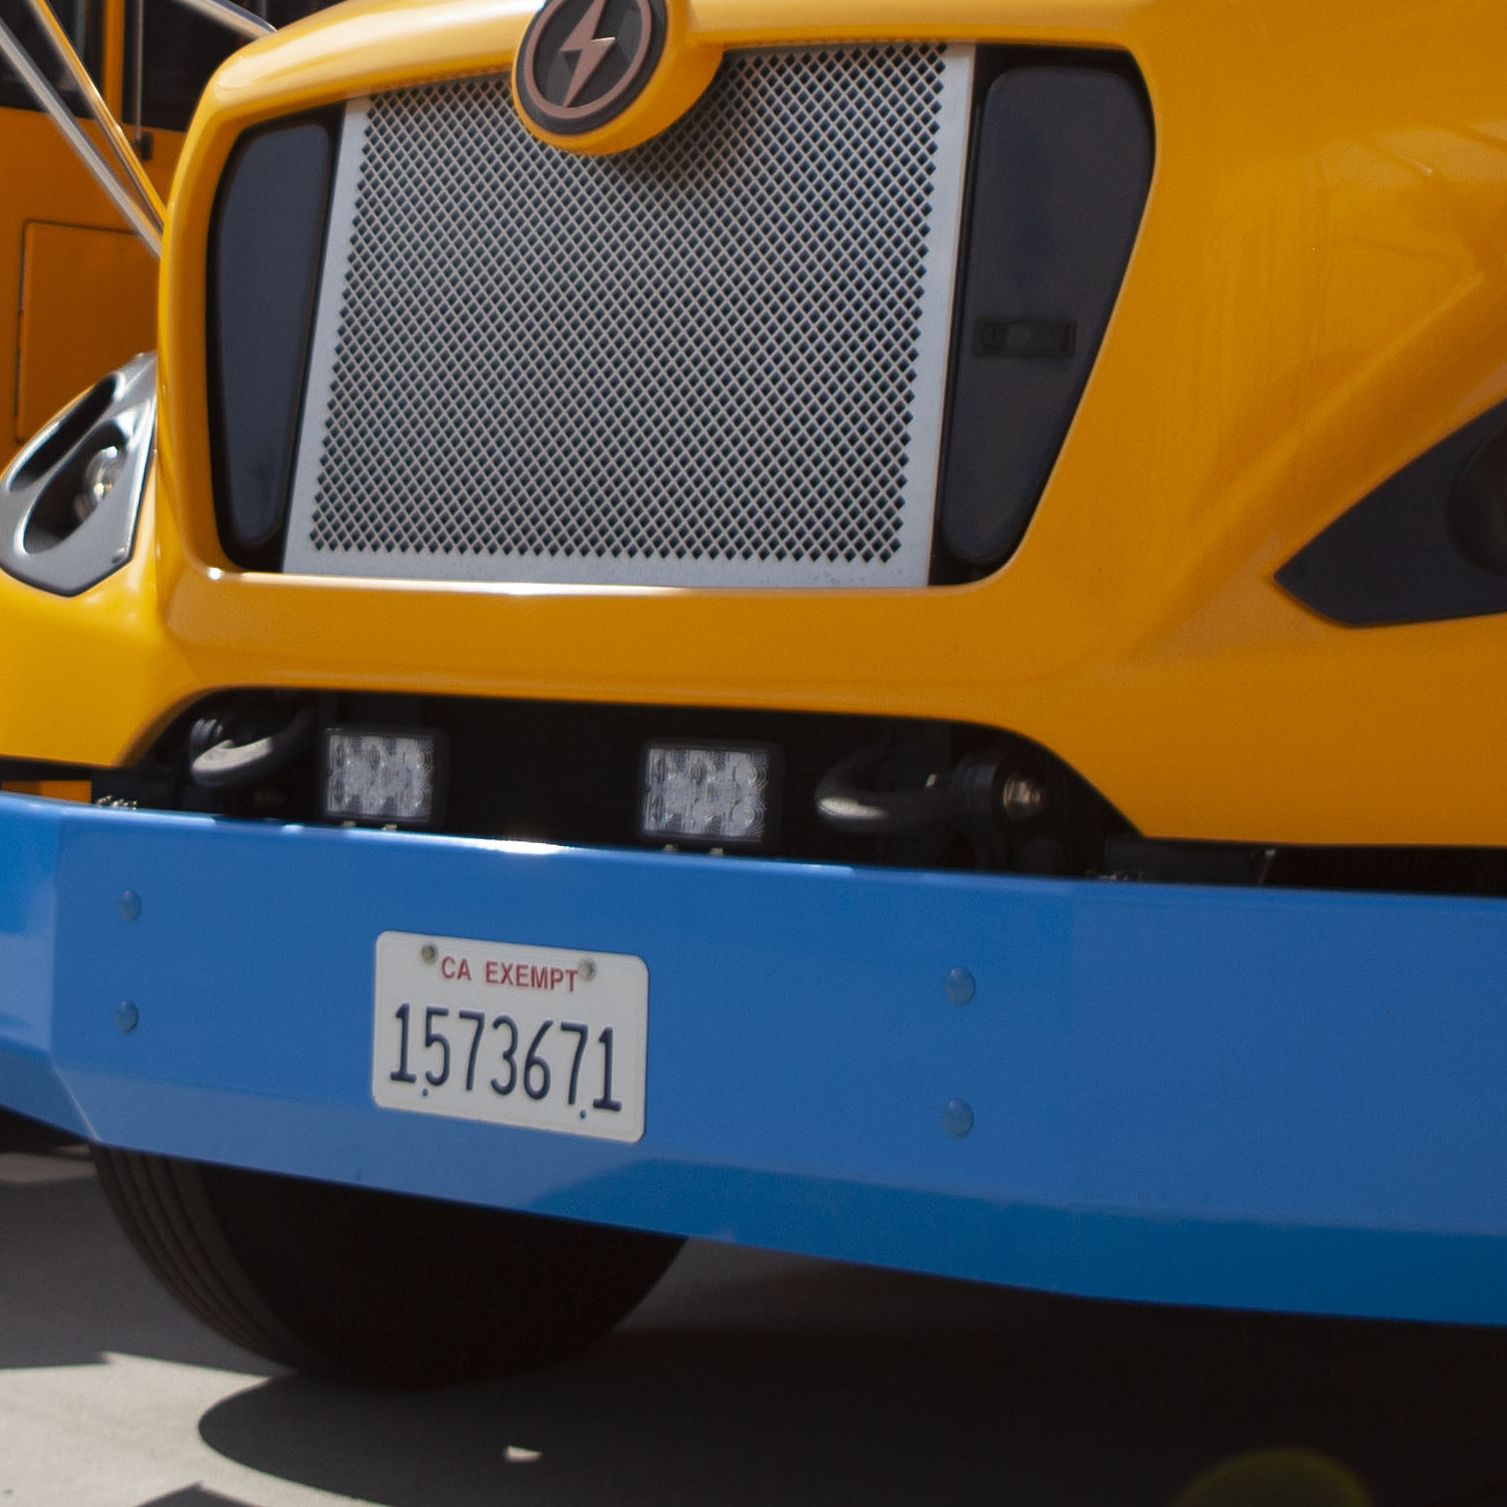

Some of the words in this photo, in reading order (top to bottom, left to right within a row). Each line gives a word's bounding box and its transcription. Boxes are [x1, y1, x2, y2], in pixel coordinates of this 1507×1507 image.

[441, 955, 472, 981] CA
[485, 960, 579, 993] EXEMPT
[389, 1002, 623, 1112] 1573671
